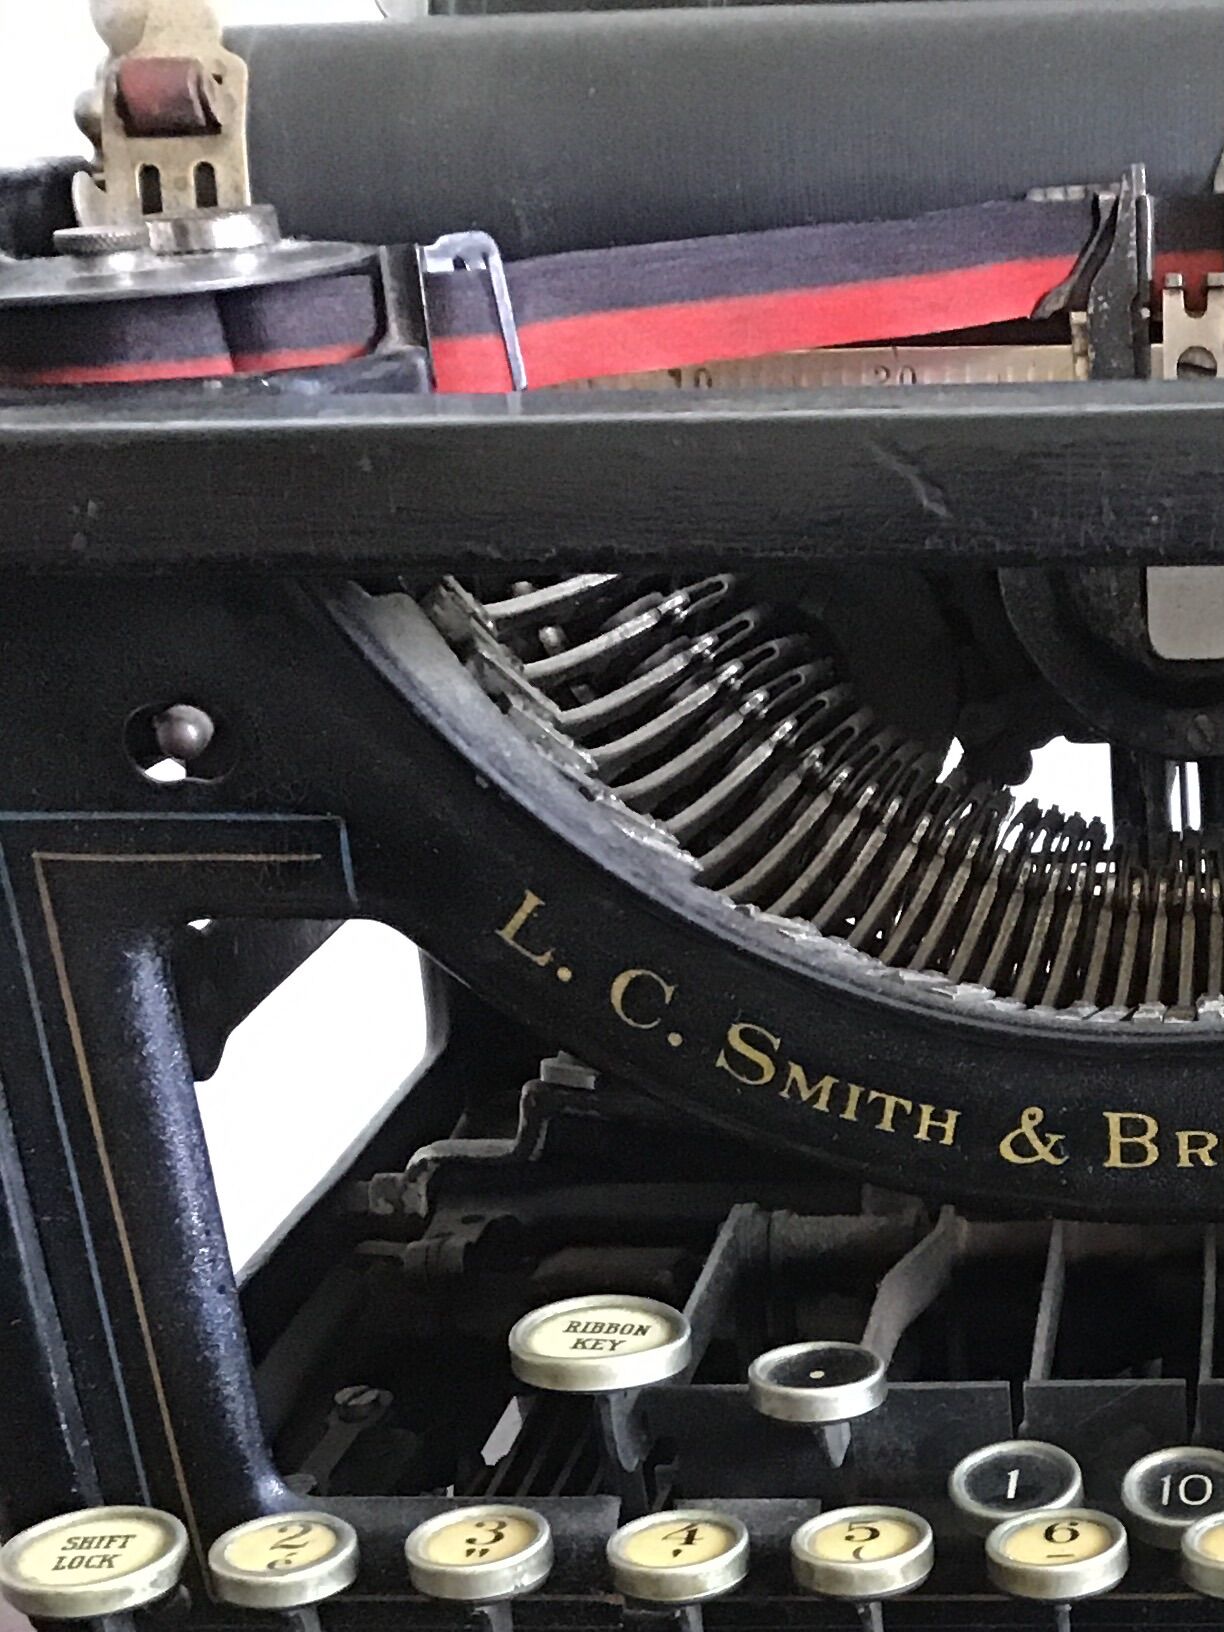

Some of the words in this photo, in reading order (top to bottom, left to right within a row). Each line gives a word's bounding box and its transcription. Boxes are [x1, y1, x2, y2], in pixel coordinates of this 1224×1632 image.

[495, 889, 573, 983] L.
[610, 969, 684, 1048] C.
[999, 1106, 1070, 1166] &
[562, 1320, 652, 1337] RIBBON
[569, 1337, 626, 1352] KEY
[1007, 1469, 1021, 1499] 1
[1159, 1473, 1214, 1507] 10
[61, 1533, 137, 1551] SHIFT
[269, 1521, 314, 1551] 2
[465, 1520, 507, 1546] 3
[661, 1522, 704, 1546] 4
[844, 1521, 881, 1543] 5
[1043, 1521, 1080, 1544] 6
[52, 1554, 124, 1572] LOCK
